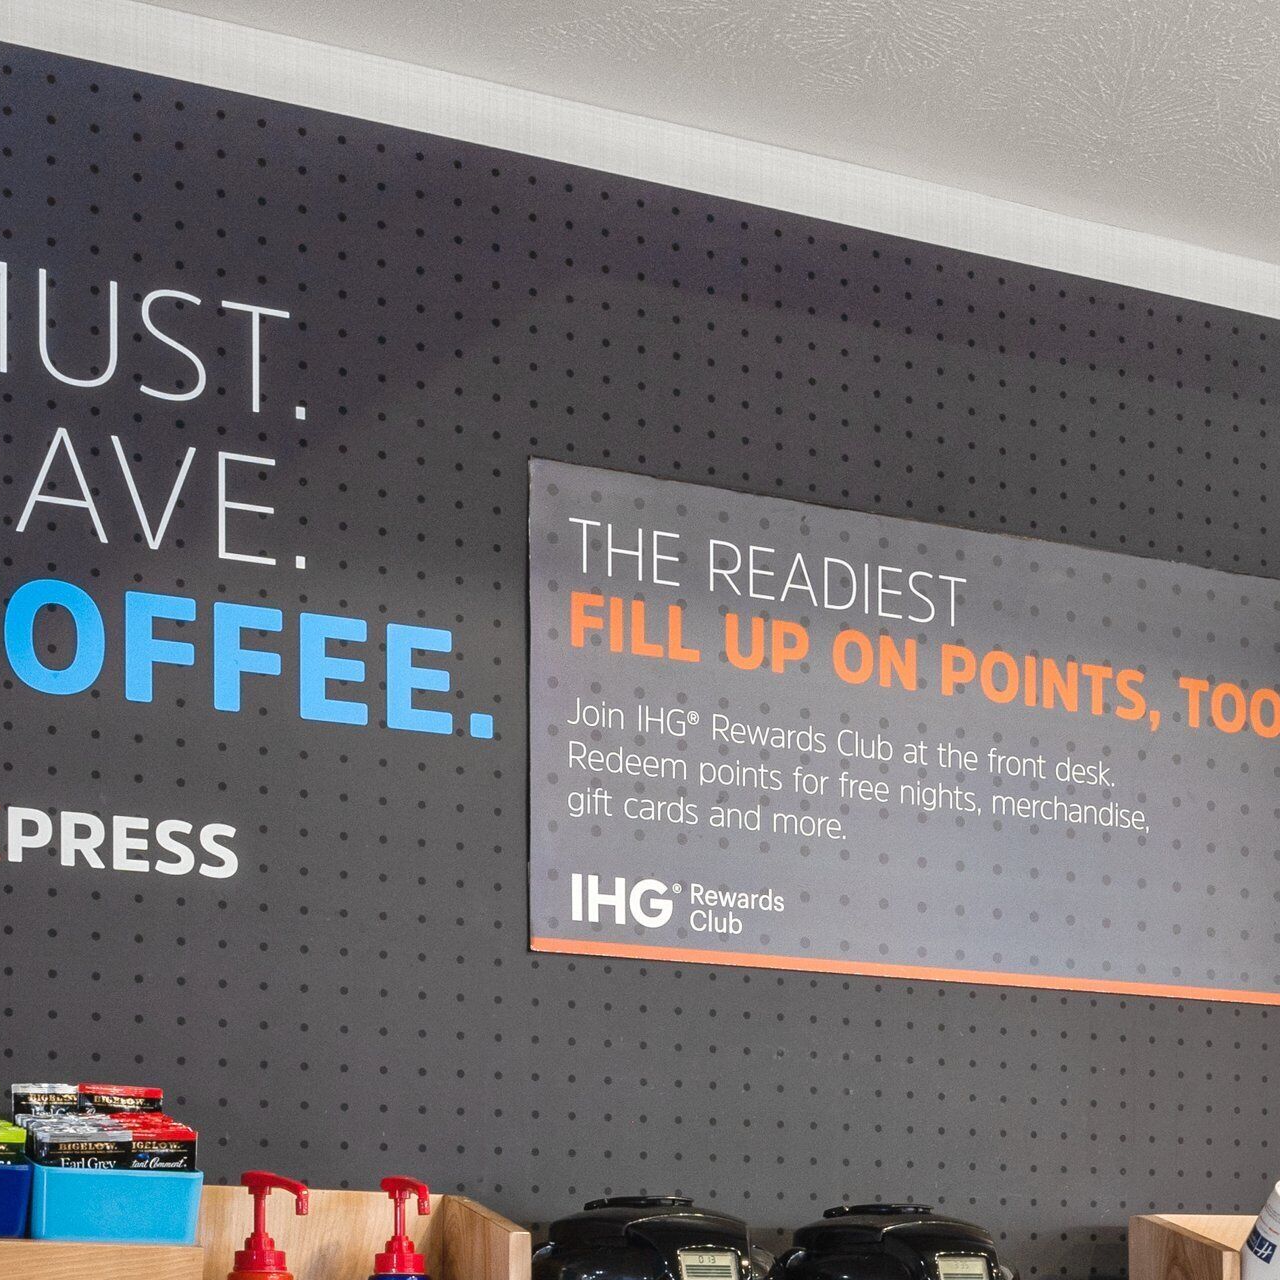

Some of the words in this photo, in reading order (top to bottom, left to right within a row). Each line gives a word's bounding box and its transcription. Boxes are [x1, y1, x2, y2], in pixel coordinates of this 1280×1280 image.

[568, 517, 680, 587] THE
[709, 538, 967, 627] READIEST
[570, 591, 701, 663] FILL
[725, 613, 809, 674] UP
[832, 628, 917, 692] ON
[941, 643, 1161, 732] POINTS,
[567, 697, 625, 730] Join
[711, 713, 827, 753] Rewards
[837, 729, 893, 761] Club
[903, 740, 928, 766] at
[937, 742, 978, 772] the
[987, 747, 1047, 780] front
[1055, 757, 1115, 788] desk.
[567, 787, 613, 818] gift
[623, 796, 699, 825] cards
[709, 805, 761, 832] and
[773, 812, 847, 840] more.
[568, 740, 687, 781] Redeem
[699, 760, 783, 791] points
[792, 766, 829, 796] for
[839, 771, 890, 803] free
[900, 780, 982, 816] nights,
[992, 794, 1150, 834] merchandise,
[689, 909, 743, 935] Club
[690, 883, 785, 912] Rewards
[61, 1158, 85, 1169] Earl
